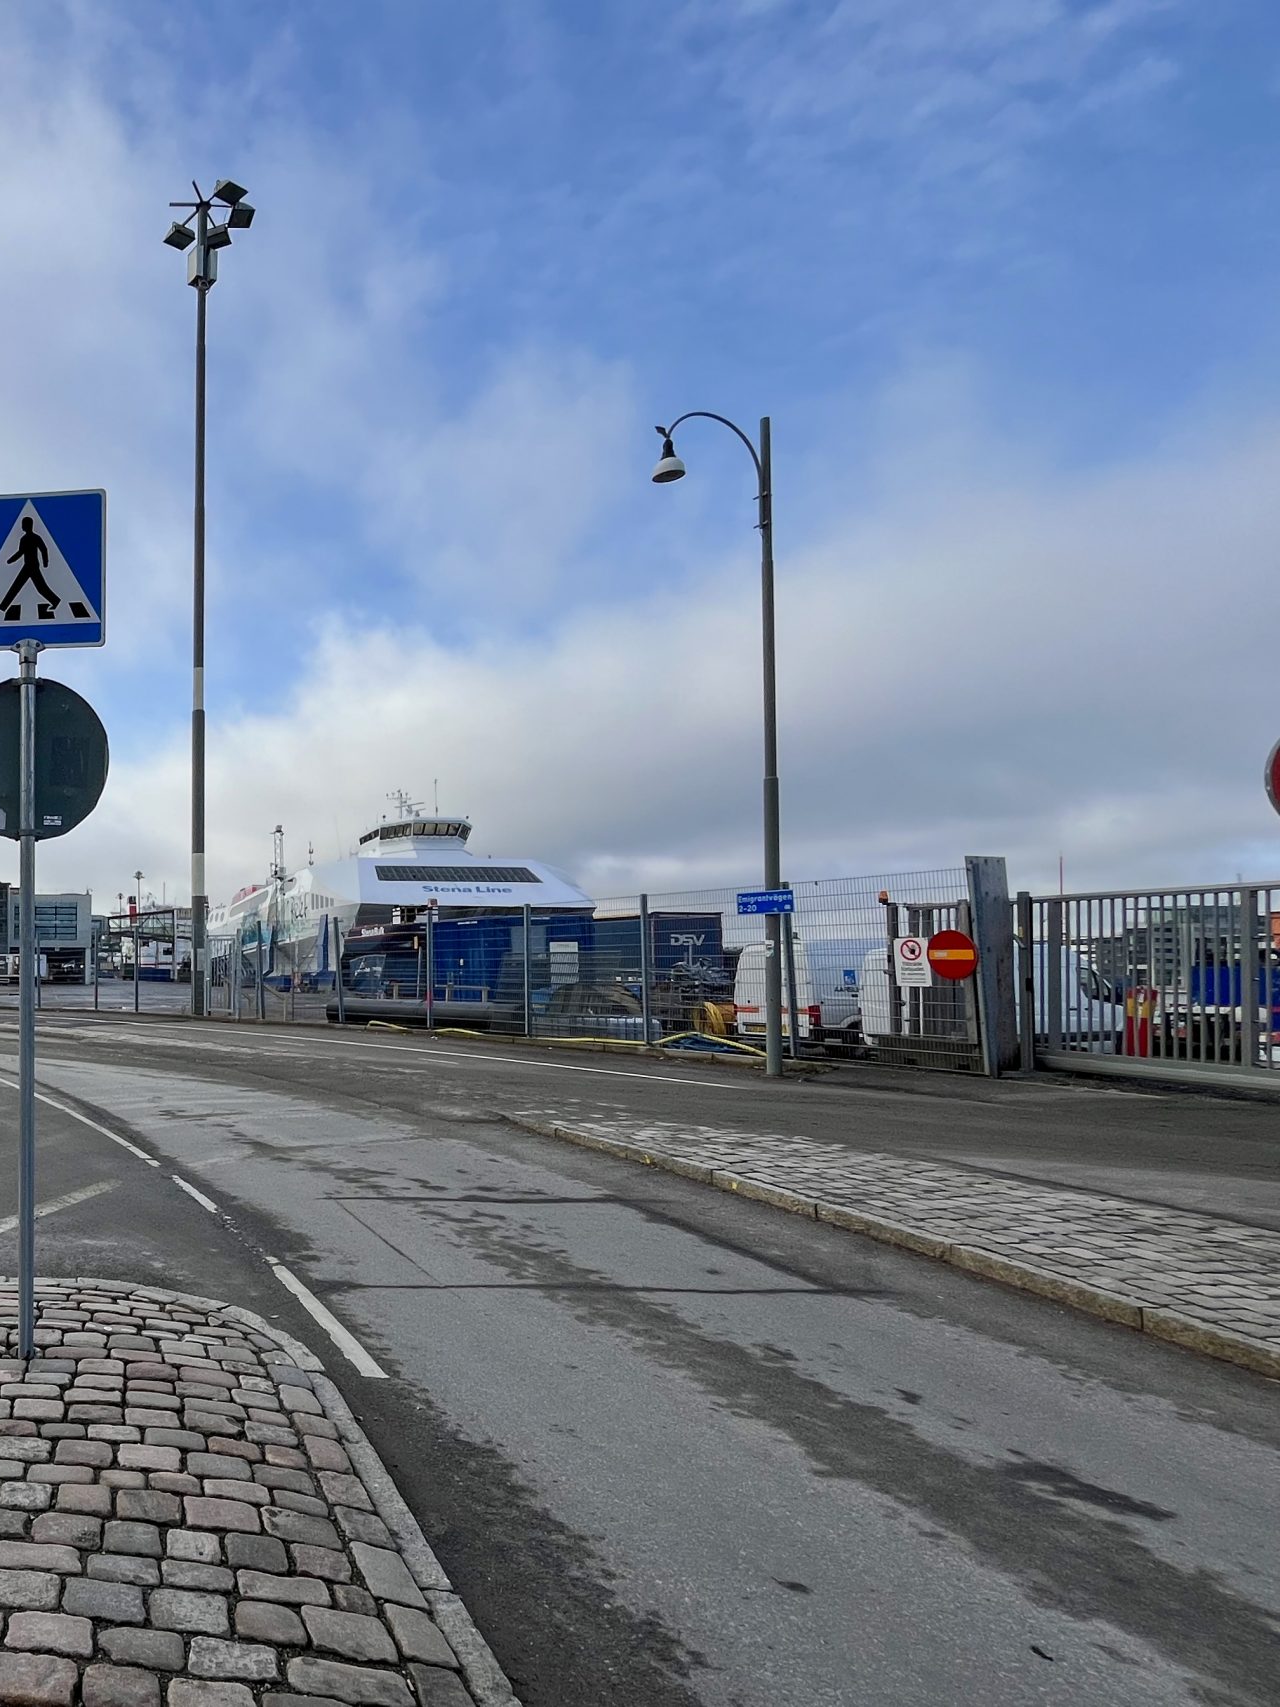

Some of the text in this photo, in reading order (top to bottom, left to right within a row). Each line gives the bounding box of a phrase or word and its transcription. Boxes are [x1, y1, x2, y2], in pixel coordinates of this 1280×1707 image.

[422, 885, 472, 893] Stena
[738, 893, 792, 904] Emigrantvägen
[738, 904, 757, 912] 2-20
[670, 933, 705, 946] DSV
